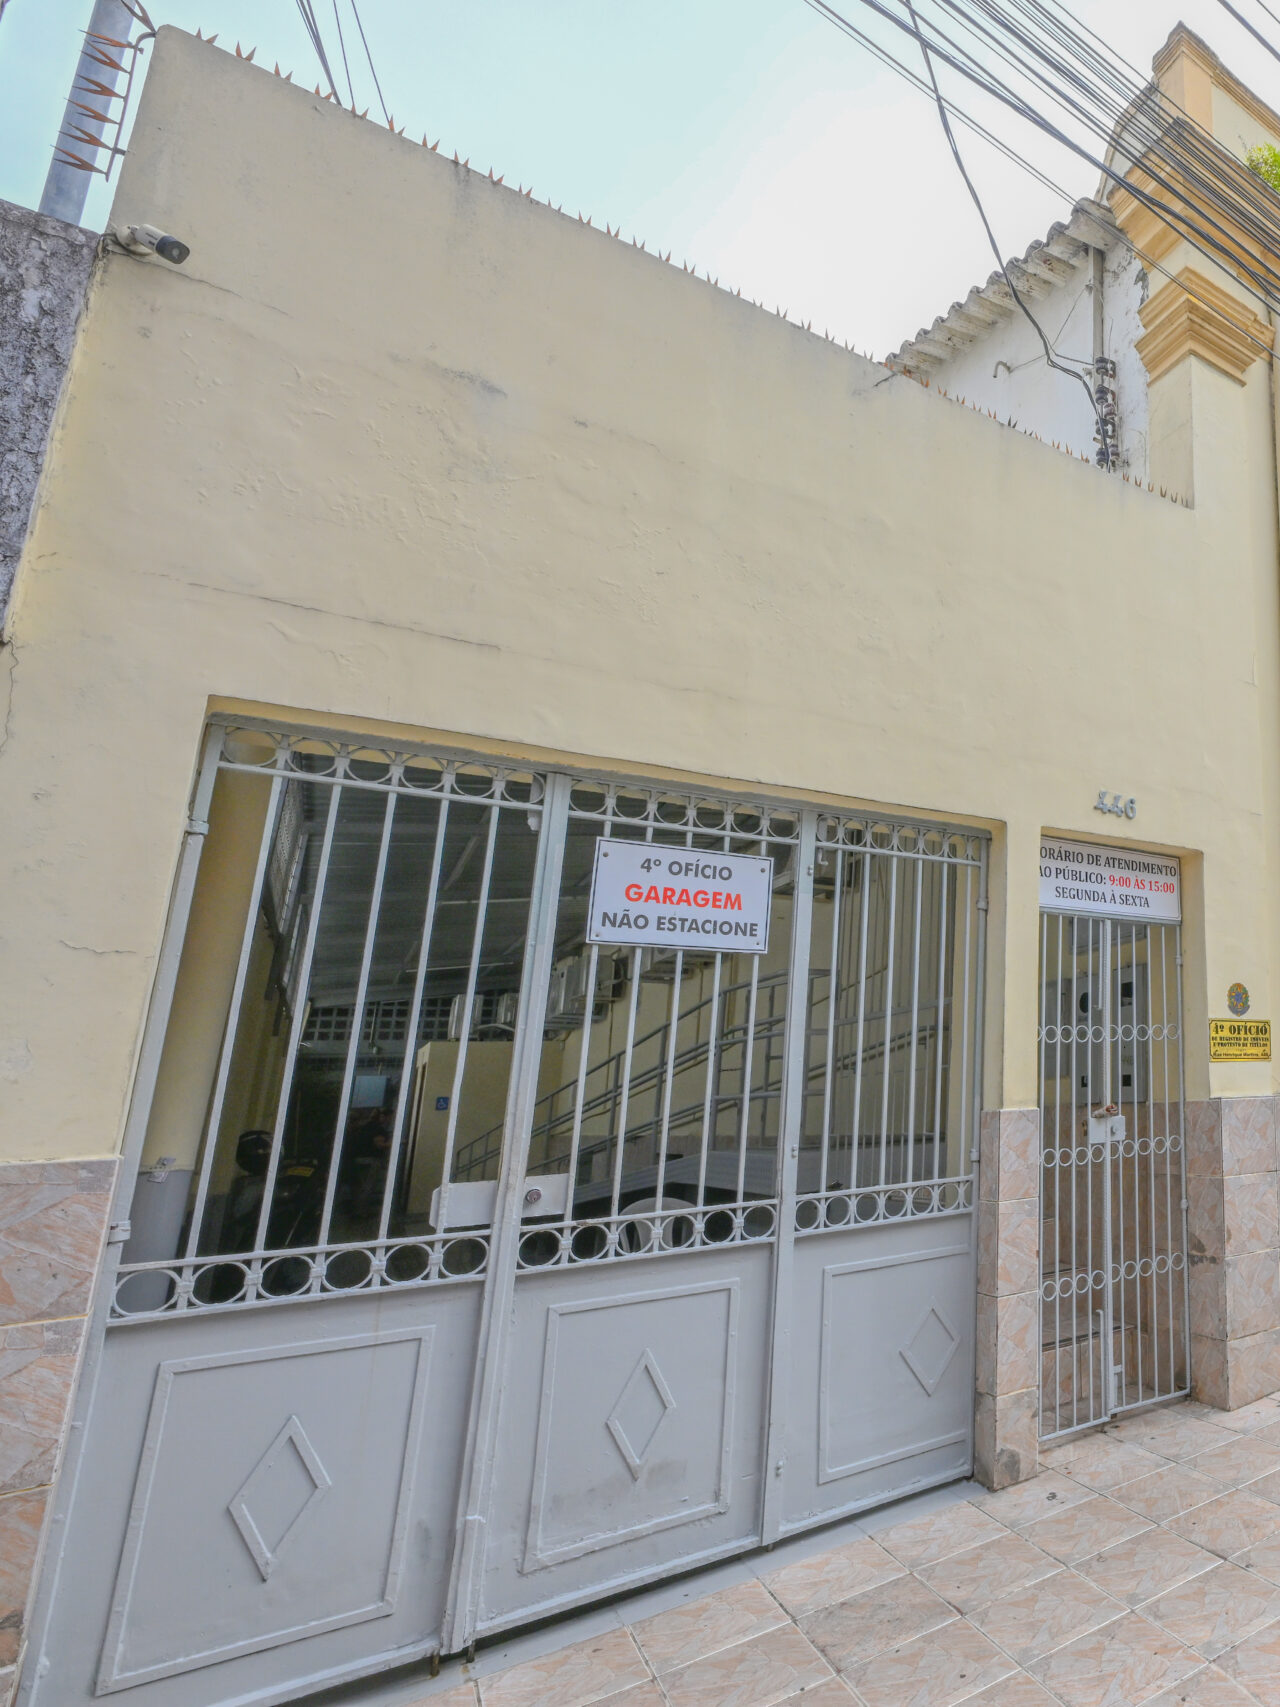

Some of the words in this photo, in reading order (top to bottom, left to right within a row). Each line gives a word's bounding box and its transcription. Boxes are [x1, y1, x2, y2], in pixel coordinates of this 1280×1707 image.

[1094, 789, 1136, 820] 446
[640, 858, 662, 873] 4º
[668, 859, 733, 881] OFÍCIO
[1040, 846, 1084, 864] ORÁRIO
[1086, 853, 1102, 867] DE
[1104, 856, 1177, 877] ATENDIMENTO
[1055, 865, 1106, 885] PÚBLICO:
[1109, 874, 1131, 889] 9:00
[1149, 880, 1175, 894] 15:00
[624, 883, 743, 911] GARAGEM
[1055, 886, 1107, 904] SEGUNDA
[1119, 893, 1150, 908] SEXTA
[601, 909, 649, 930] NÃO
[656, 915, 759, 937] ESTACIONE
[1229, 1022, 1268, 1036] OFÍCIO
